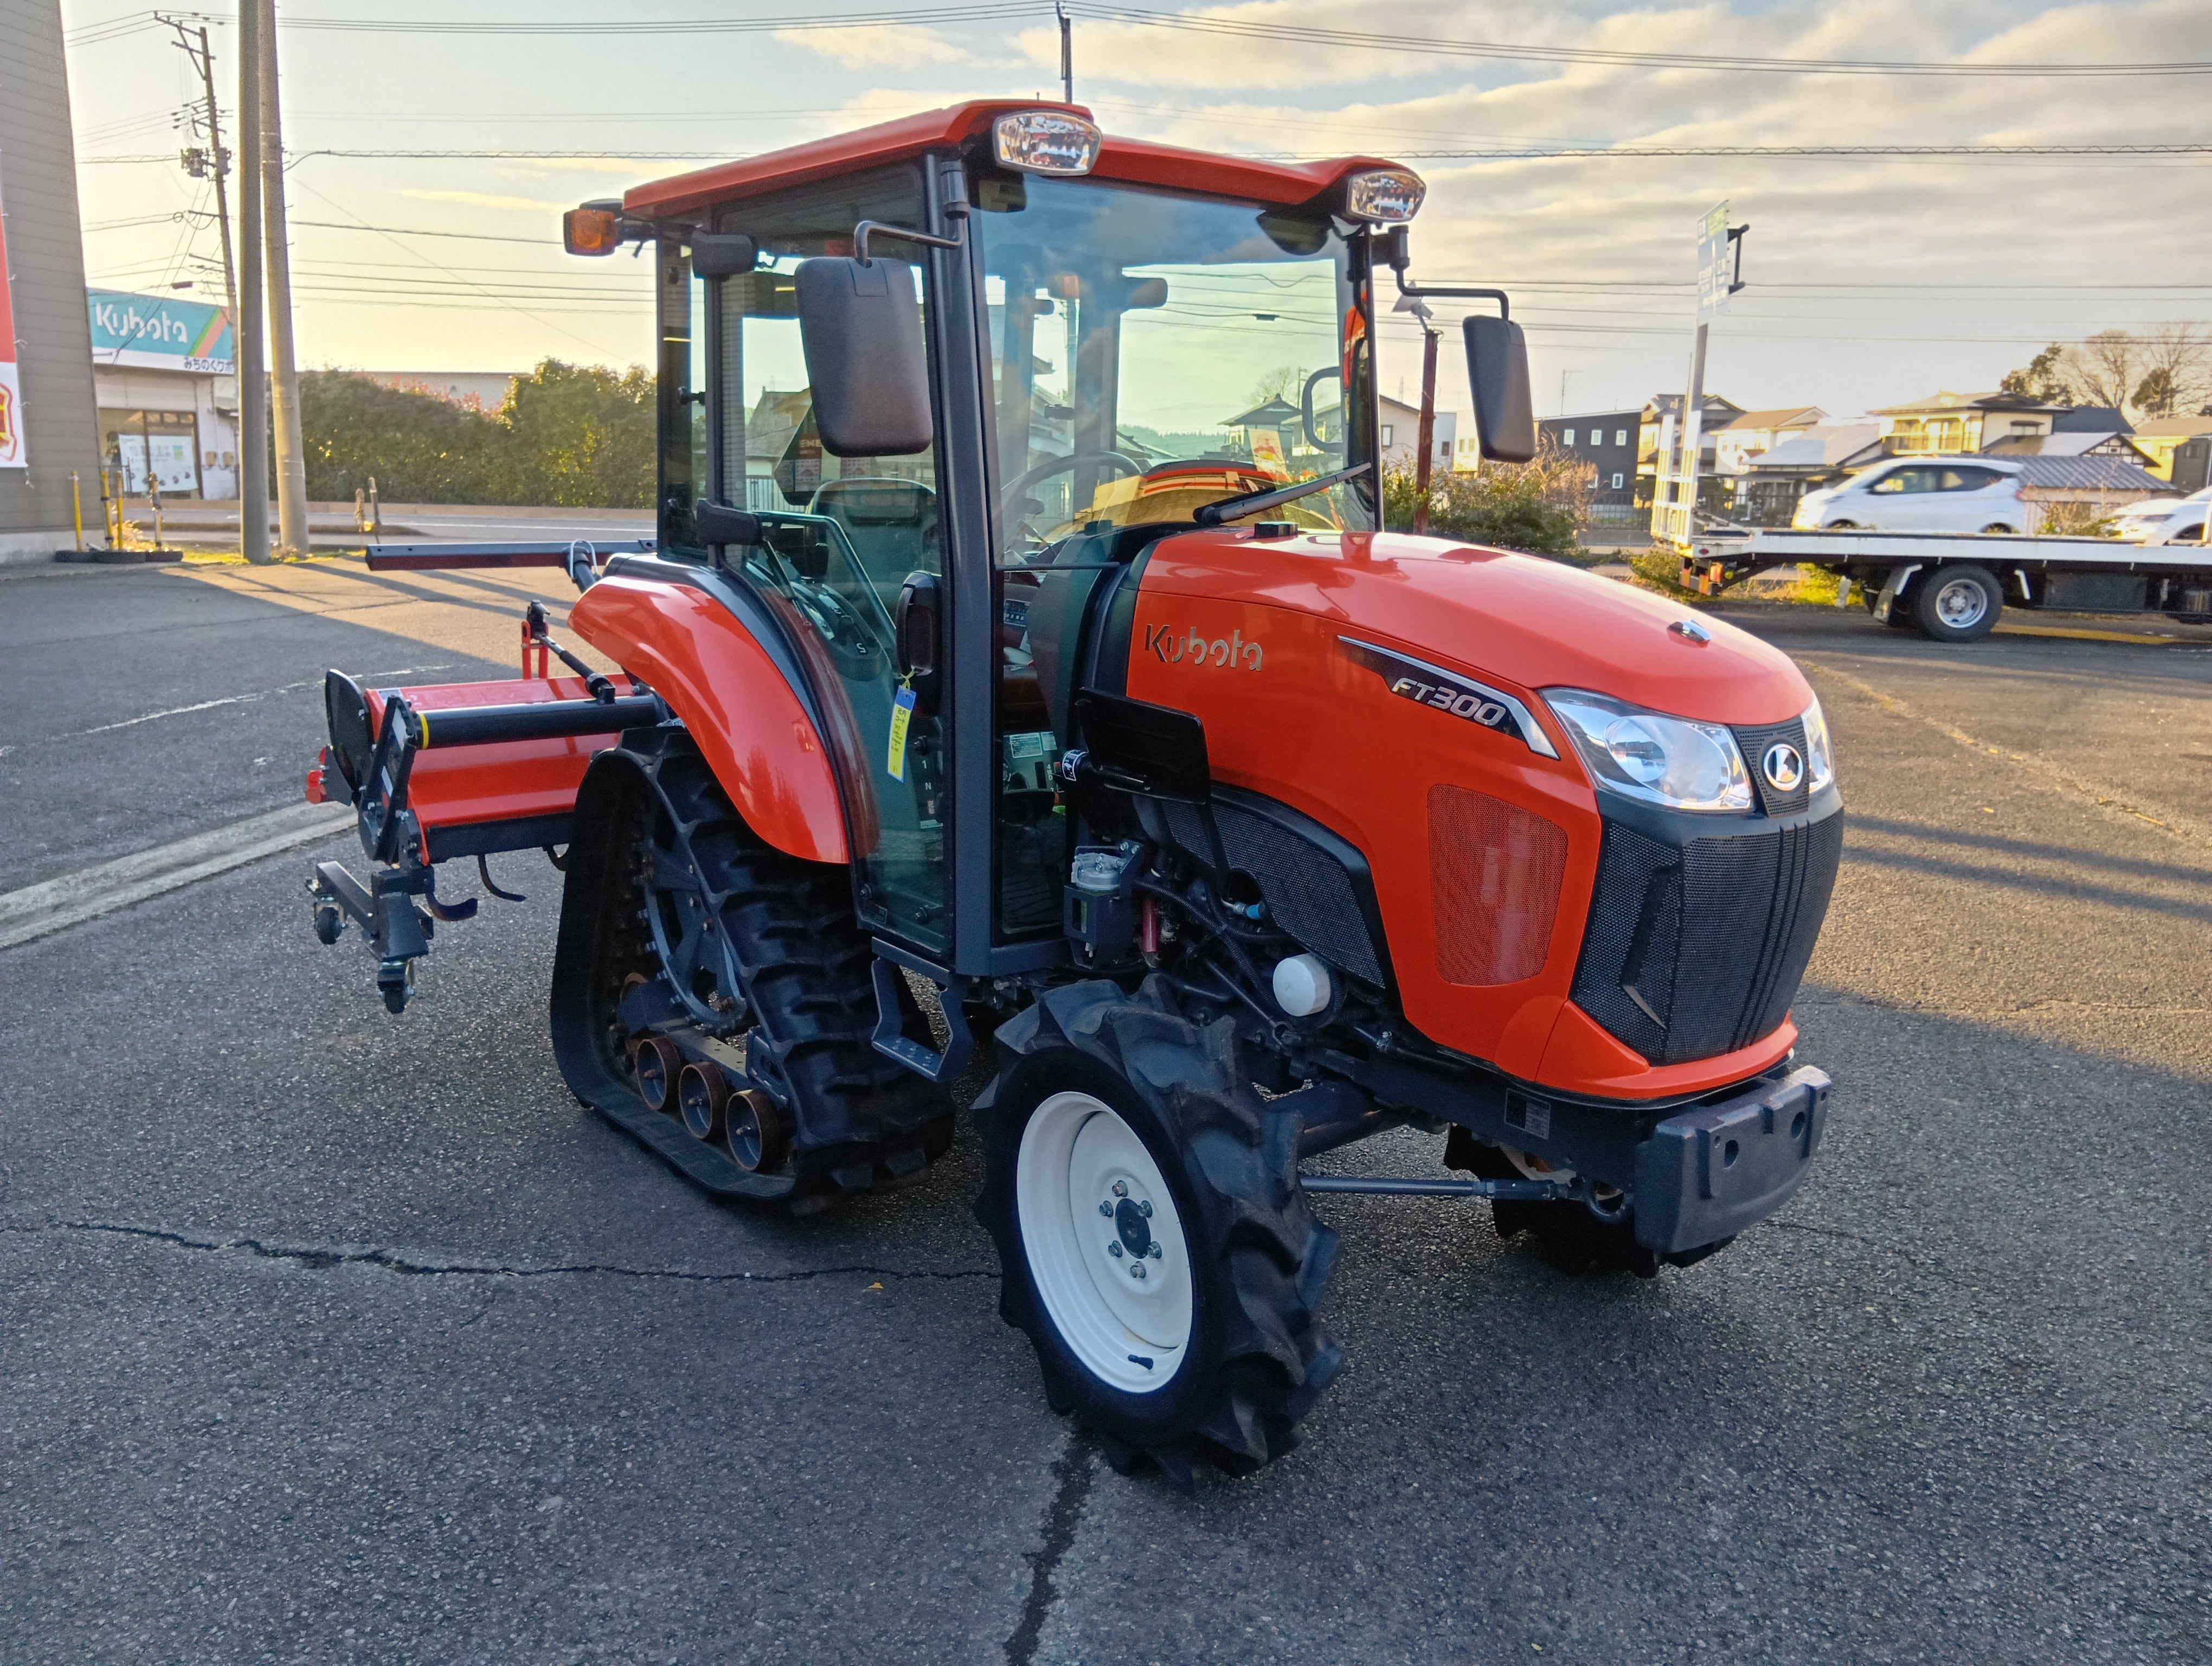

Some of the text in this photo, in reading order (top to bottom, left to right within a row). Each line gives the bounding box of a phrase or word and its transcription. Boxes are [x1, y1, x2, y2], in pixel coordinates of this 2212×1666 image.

[96, 302, 188, 343] Kubota
[1145, 624, 1263, 671] Kubota
[1392, 677, 1506, 726] FT300
[922, 760, 927, 769] 1
[925, 782, 931, 790] N
